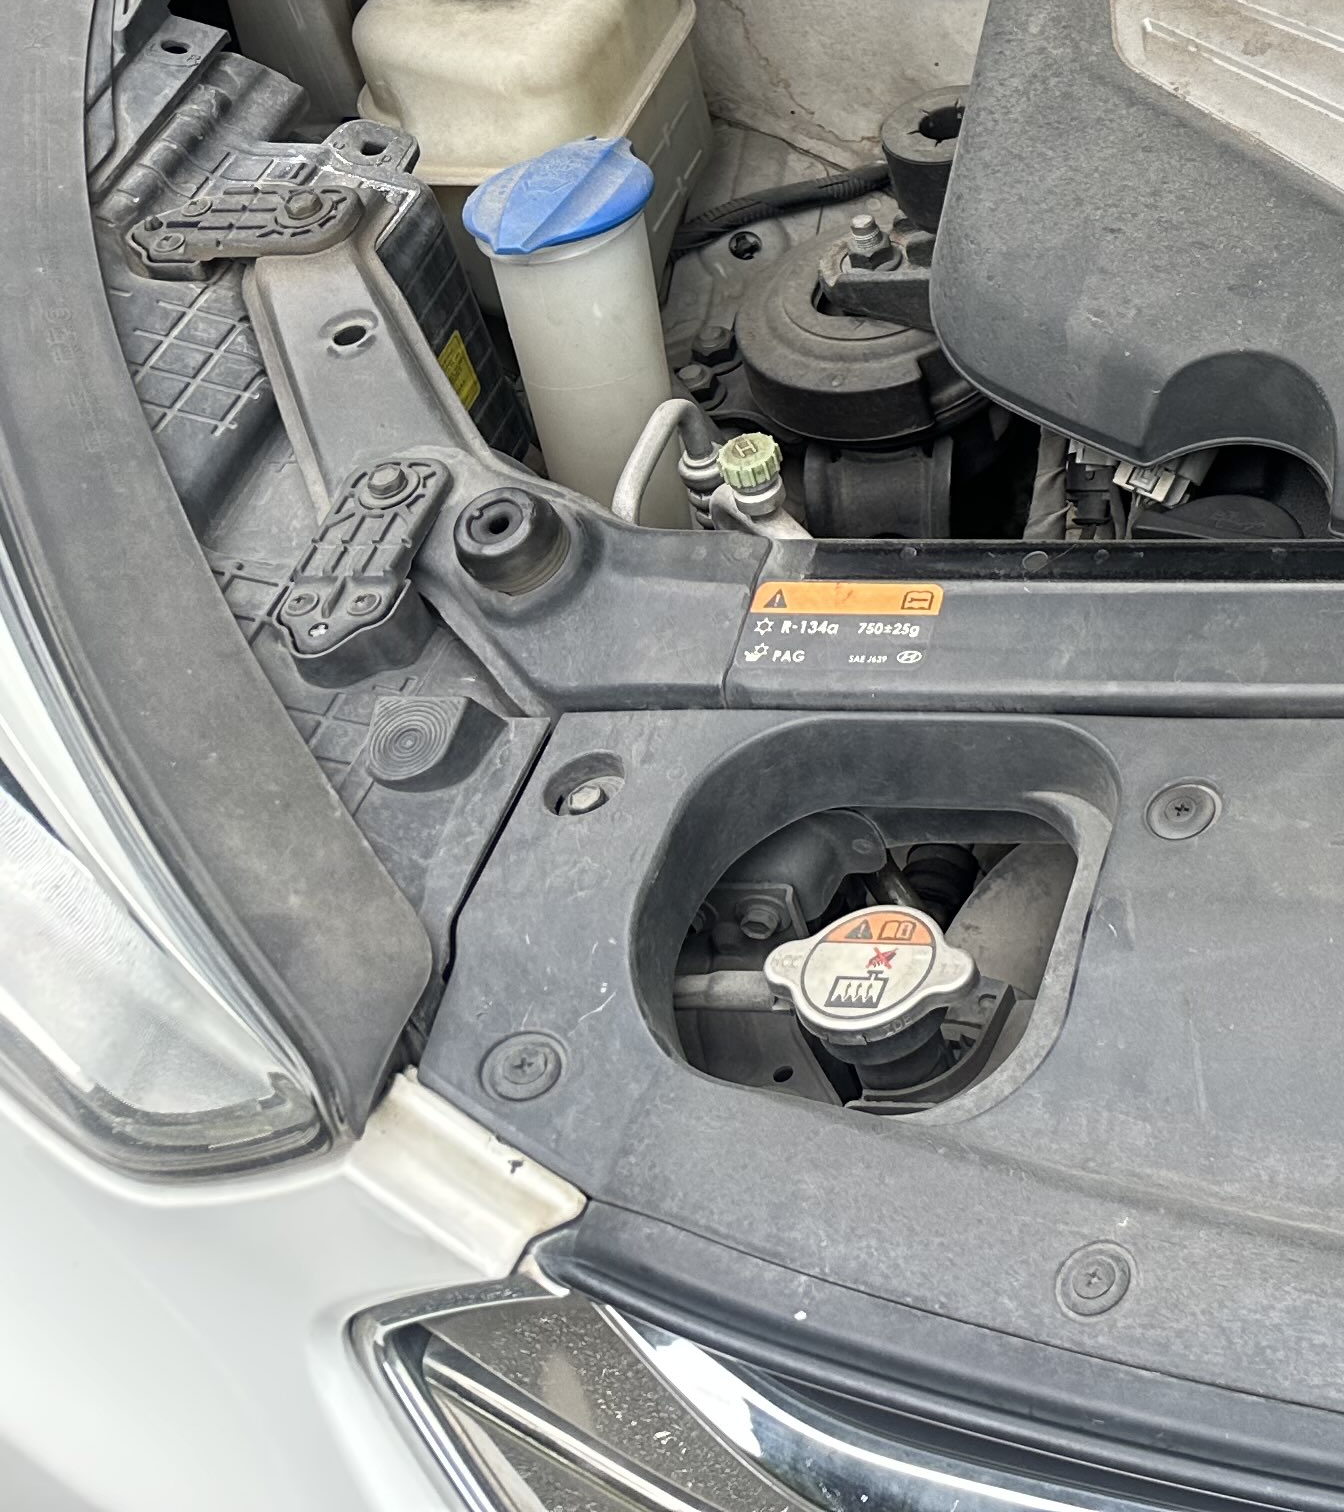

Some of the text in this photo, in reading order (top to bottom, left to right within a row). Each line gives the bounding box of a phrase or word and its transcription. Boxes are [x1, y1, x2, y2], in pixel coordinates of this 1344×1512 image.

[735, 438, 757, 458] H
[780, 619, 921, 638] R-134a 750±25g
[772, 649, 806, 663] PAG
[848, 654, 866, 664] SAE
